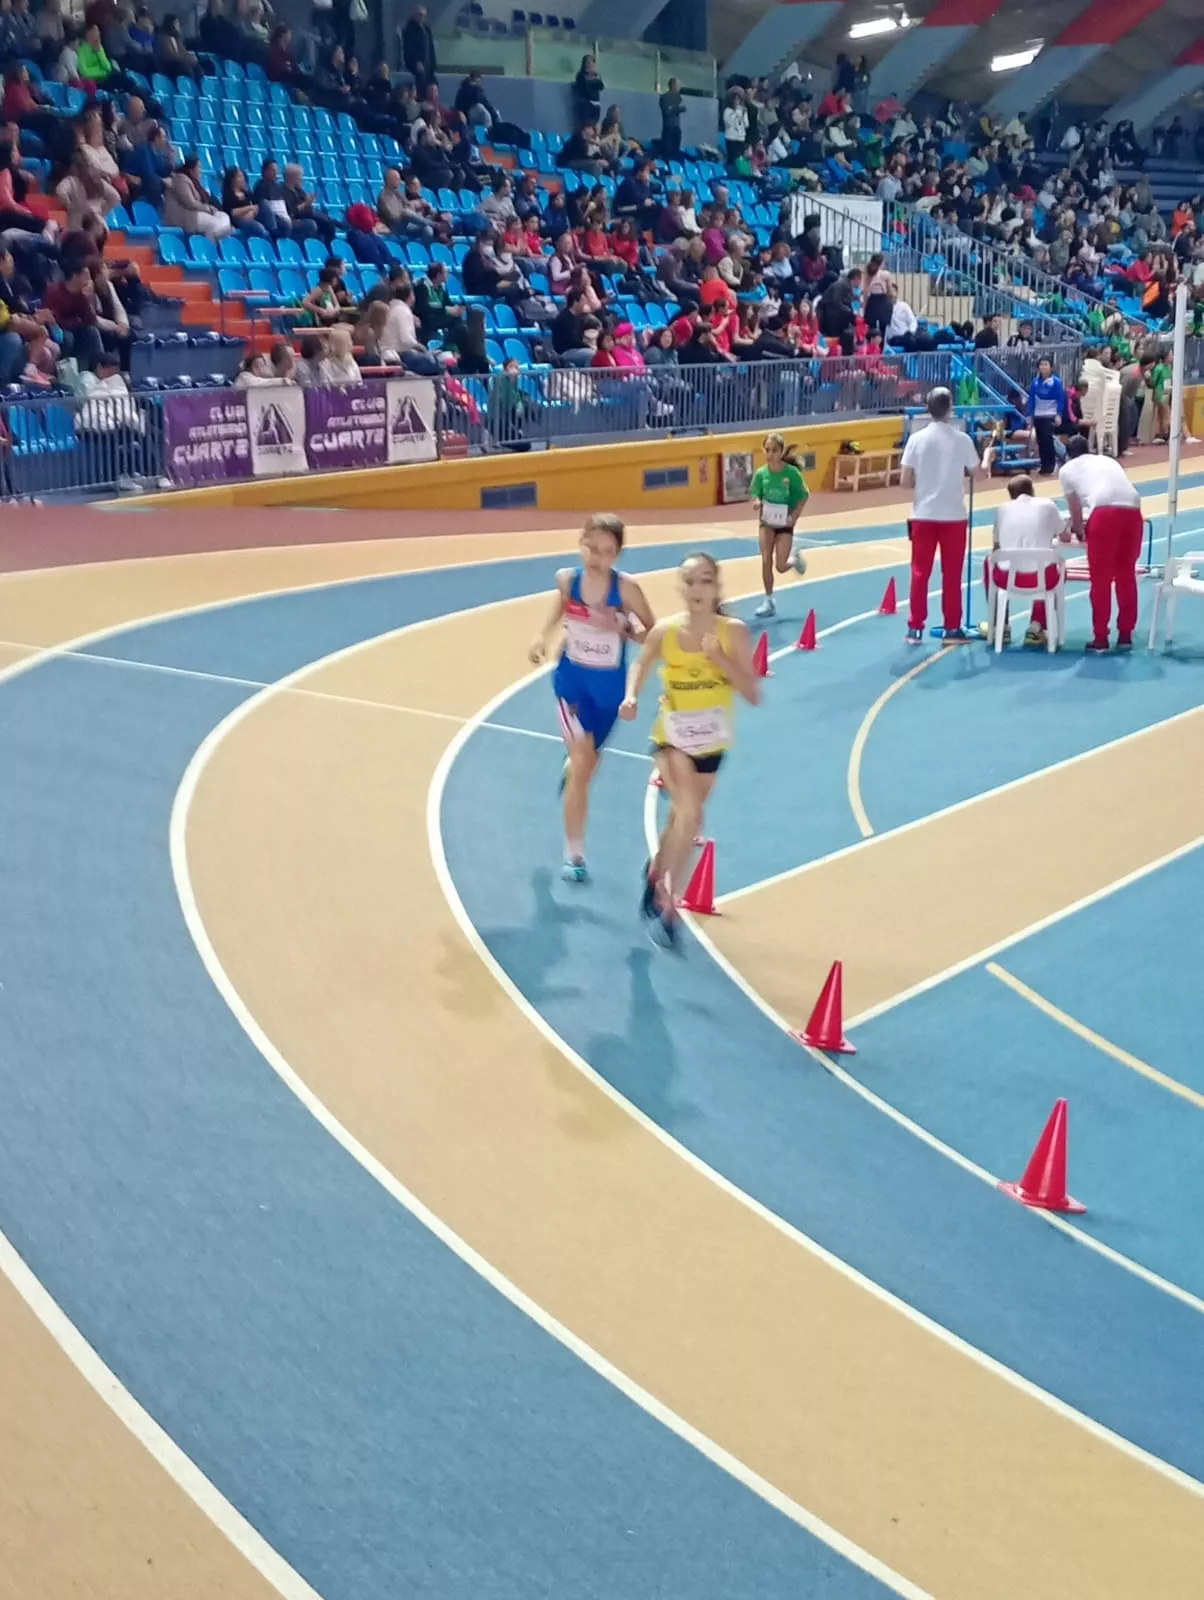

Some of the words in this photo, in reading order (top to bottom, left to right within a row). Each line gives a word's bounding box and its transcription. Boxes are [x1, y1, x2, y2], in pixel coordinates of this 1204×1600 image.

[209, 405, 247, 421] CLUB
[351, 397, 385, 412] CLUB
[310, 428, 386, 452] CUARTE
[173, 438, 249, 465] CUARTE
